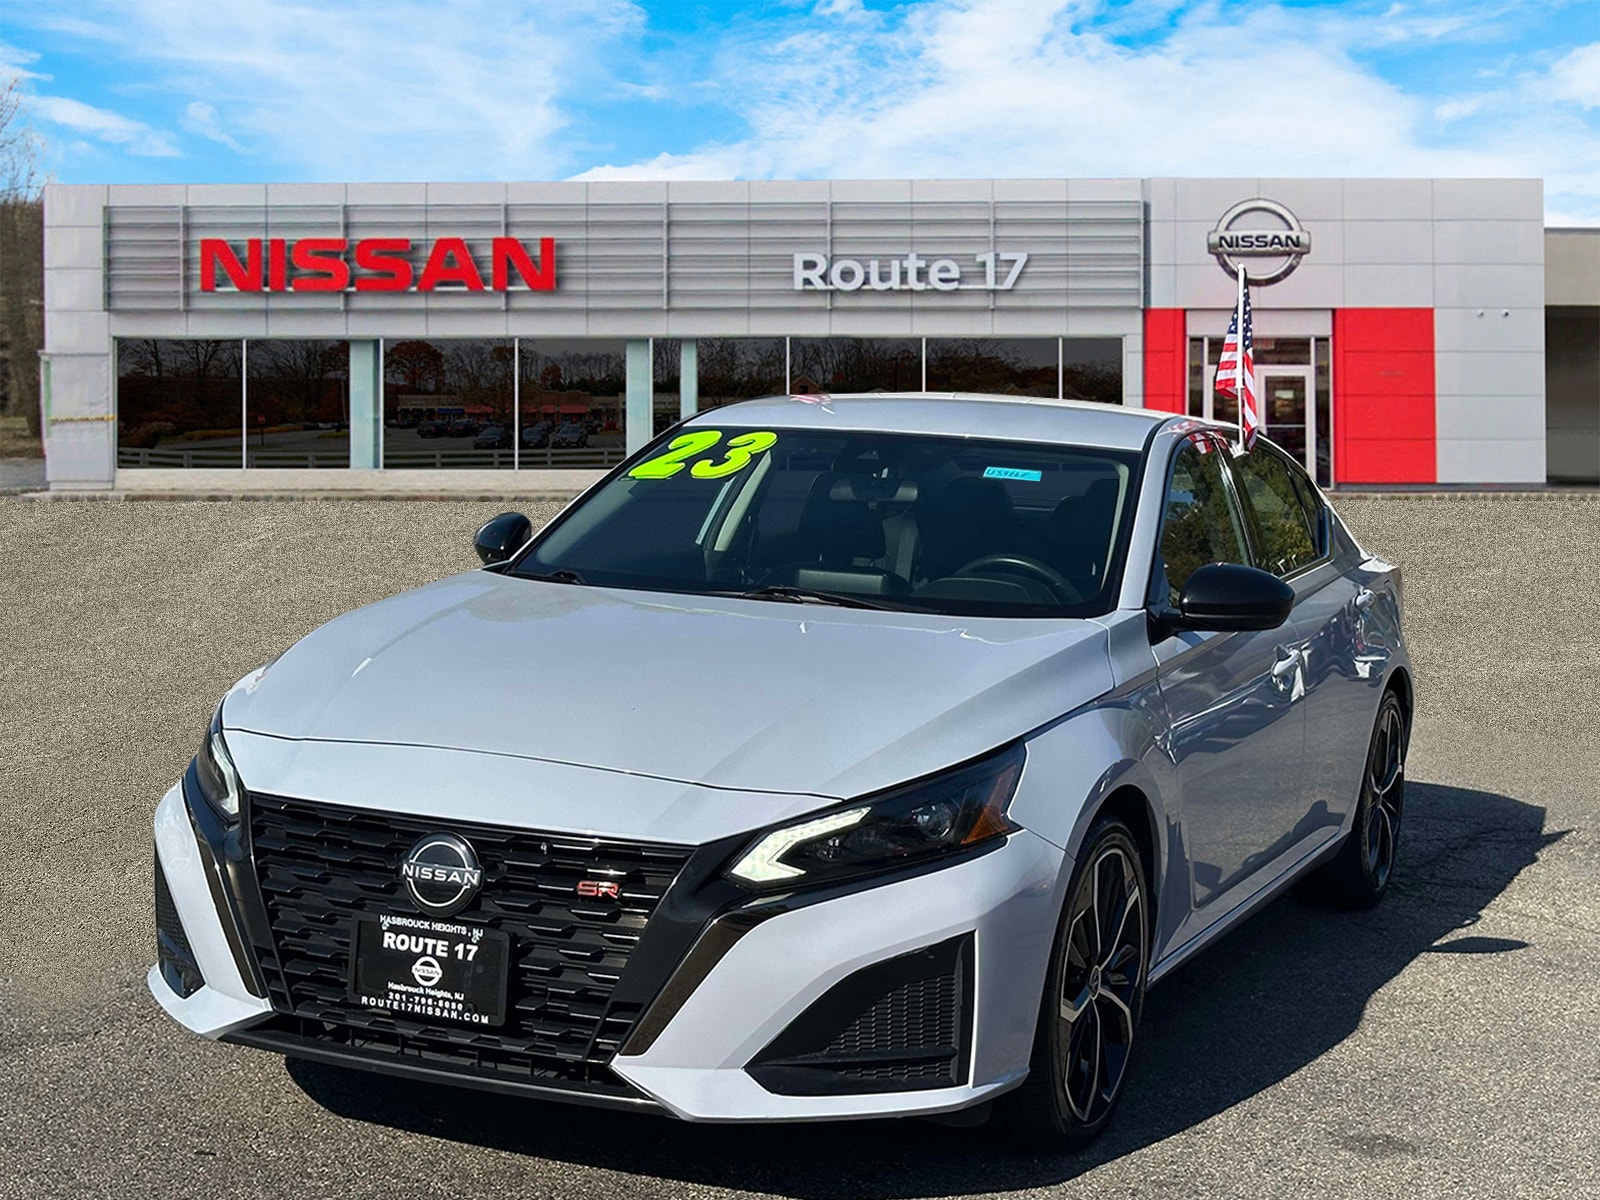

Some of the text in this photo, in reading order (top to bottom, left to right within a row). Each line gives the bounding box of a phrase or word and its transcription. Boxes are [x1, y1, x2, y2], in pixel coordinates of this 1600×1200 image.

[1219, 234, 1300, 248] NISSAN
[200, 237, 556, 292] NISSAN
[793, 252, 1028, 292] Route 17
[627, 430, 778, 480] 23
[402, 863, 479, 886] NISSAN
[577, 880, 619, 899] SR
[380, 914, 430, 930] HASBROUCK
[383, 931, 479, 961] ROUTE 17
[361, 996, 489, 1024] ROUTE17NISSAN.COM
